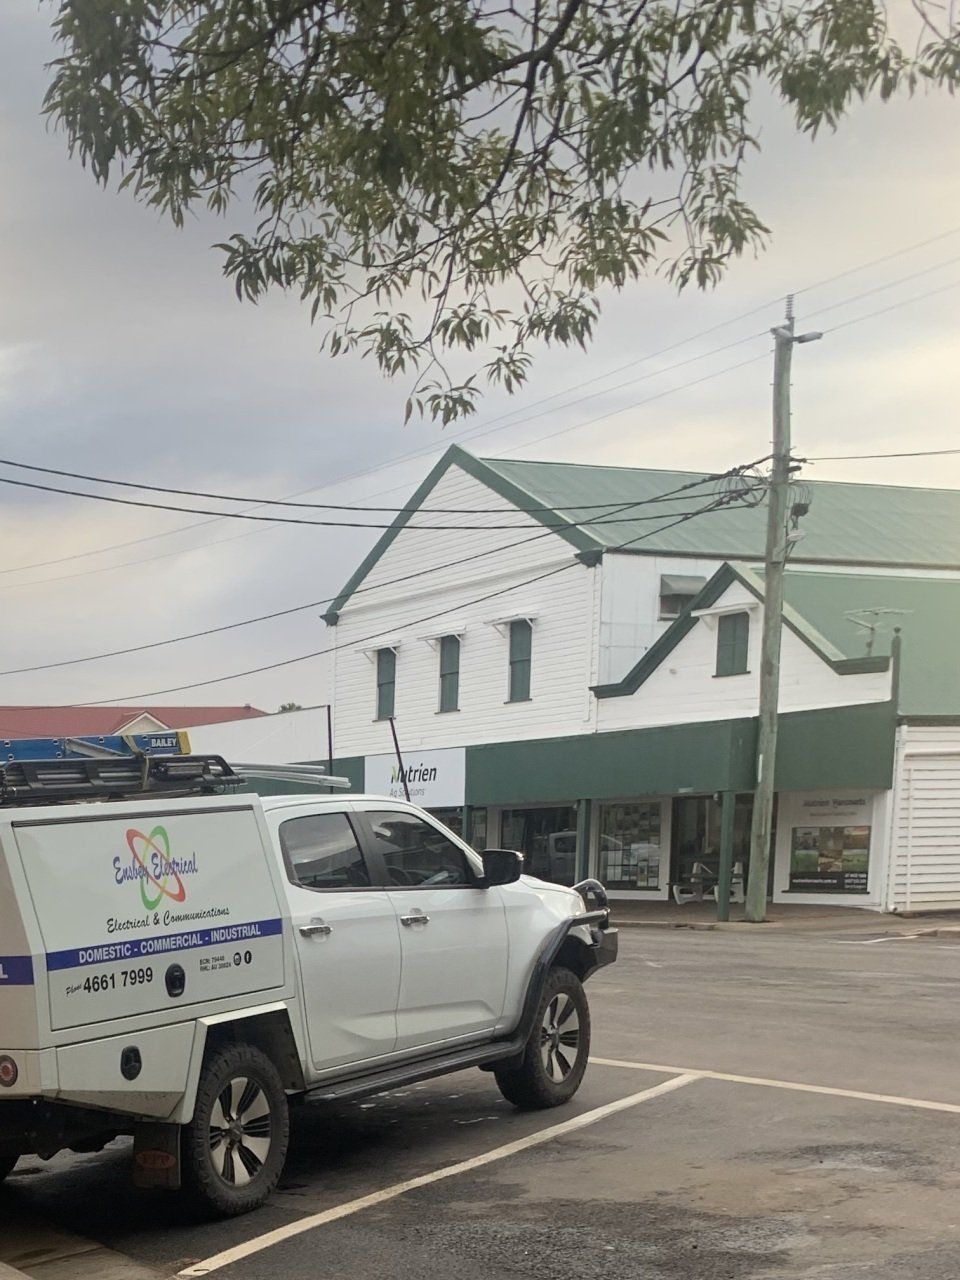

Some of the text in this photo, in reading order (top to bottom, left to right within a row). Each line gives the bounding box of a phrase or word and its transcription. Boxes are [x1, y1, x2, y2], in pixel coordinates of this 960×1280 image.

[151, 737, 177, 747] BAILEY
[391, 763, 437, 784] Nutrien
[151, 852, 198, 880] Electrical
[106, 907, 230, 933] Electrical & Communications
[79, 944, 131, 964] DOMESTIC
[141, 932, 203, 954] COMMERCIAL
[211, 924, 261, 943] INDUSTRIAL
[83, 973, 116, 993] 4661
[121, 966, 153, 987] 7999
